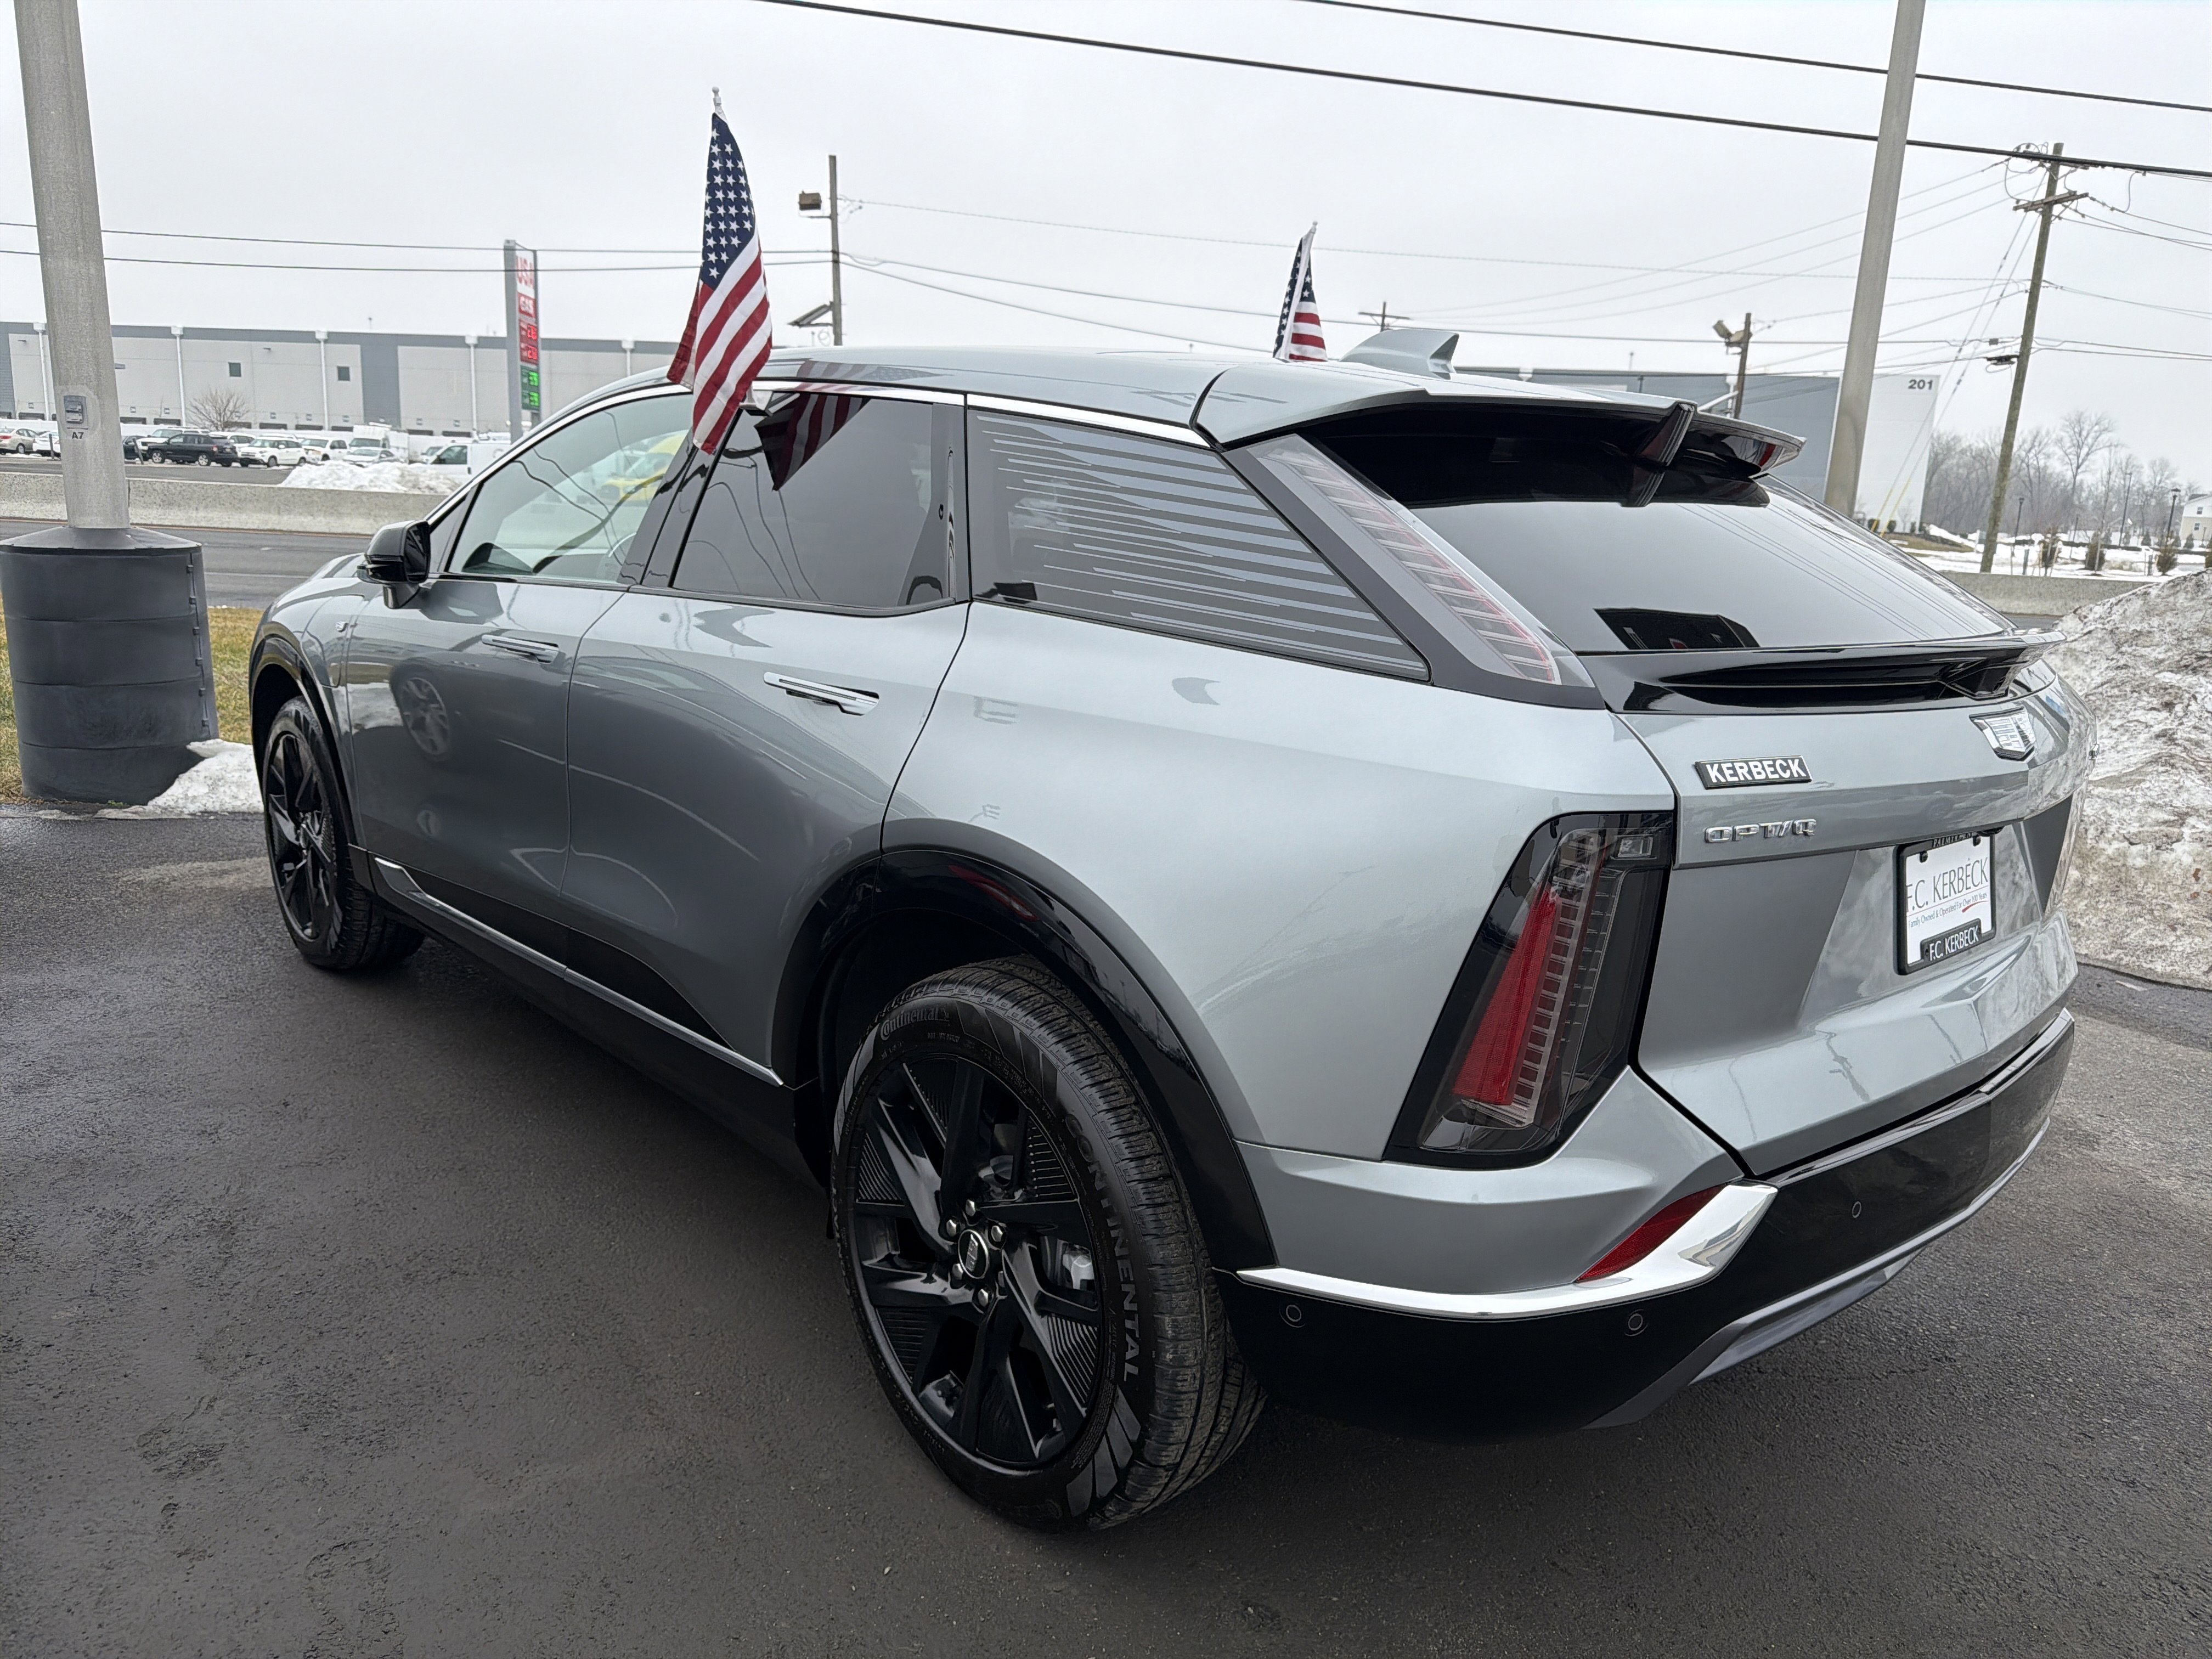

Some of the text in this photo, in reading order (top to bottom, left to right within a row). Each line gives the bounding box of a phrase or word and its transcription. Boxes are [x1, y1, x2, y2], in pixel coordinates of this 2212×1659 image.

[1908, 379, 1933, 390] 201
[72, 431, 84, 439] A7
[1706, 759, 1807, 783] KERBECK
[1704, 819, 1817, 843] OPTIQ
[1933, 857, 1988, 903] KERBECK
[1909, 916, 1921, 929] Family
[1921, 910, 1936, 924] Owned
[1939, 902, 1956, 917] Operated
[1962, 897, 1972, 907] Over
[1929, 925, 1979, 961] F.C. KERBECK
[880, 1007, 939, 1041] Continental
[1065, 1113, 1141, 1383] CONTINENTAL
